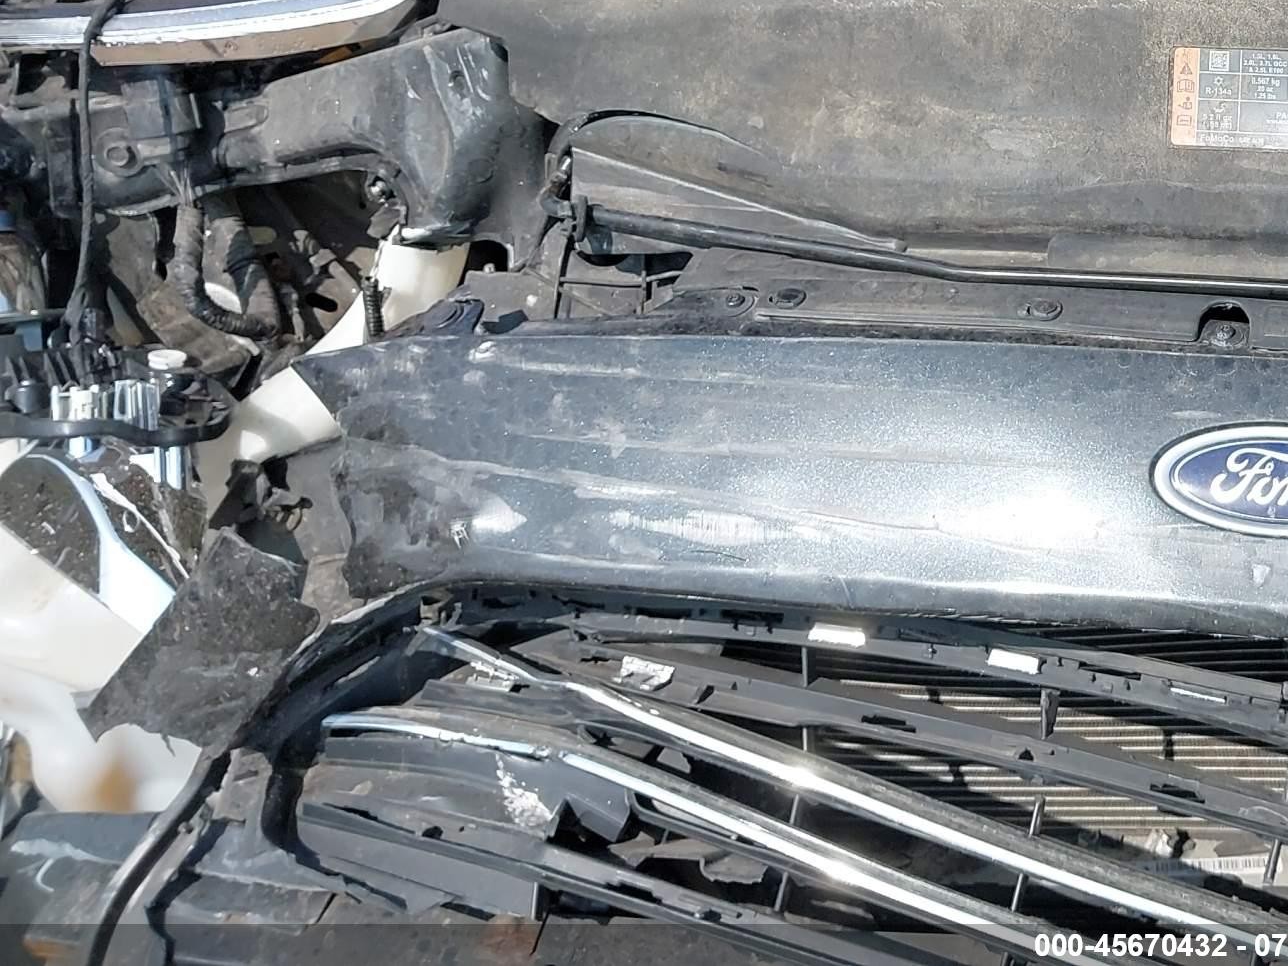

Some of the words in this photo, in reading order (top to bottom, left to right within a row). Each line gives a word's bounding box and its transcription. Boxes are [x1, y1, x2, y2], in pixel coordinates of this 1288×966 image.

[1271, 78, 1280, 87] kg
[1205, 87, 1232, 96] R-134a
[1200, 134, 1234, 143] FoMoCo
